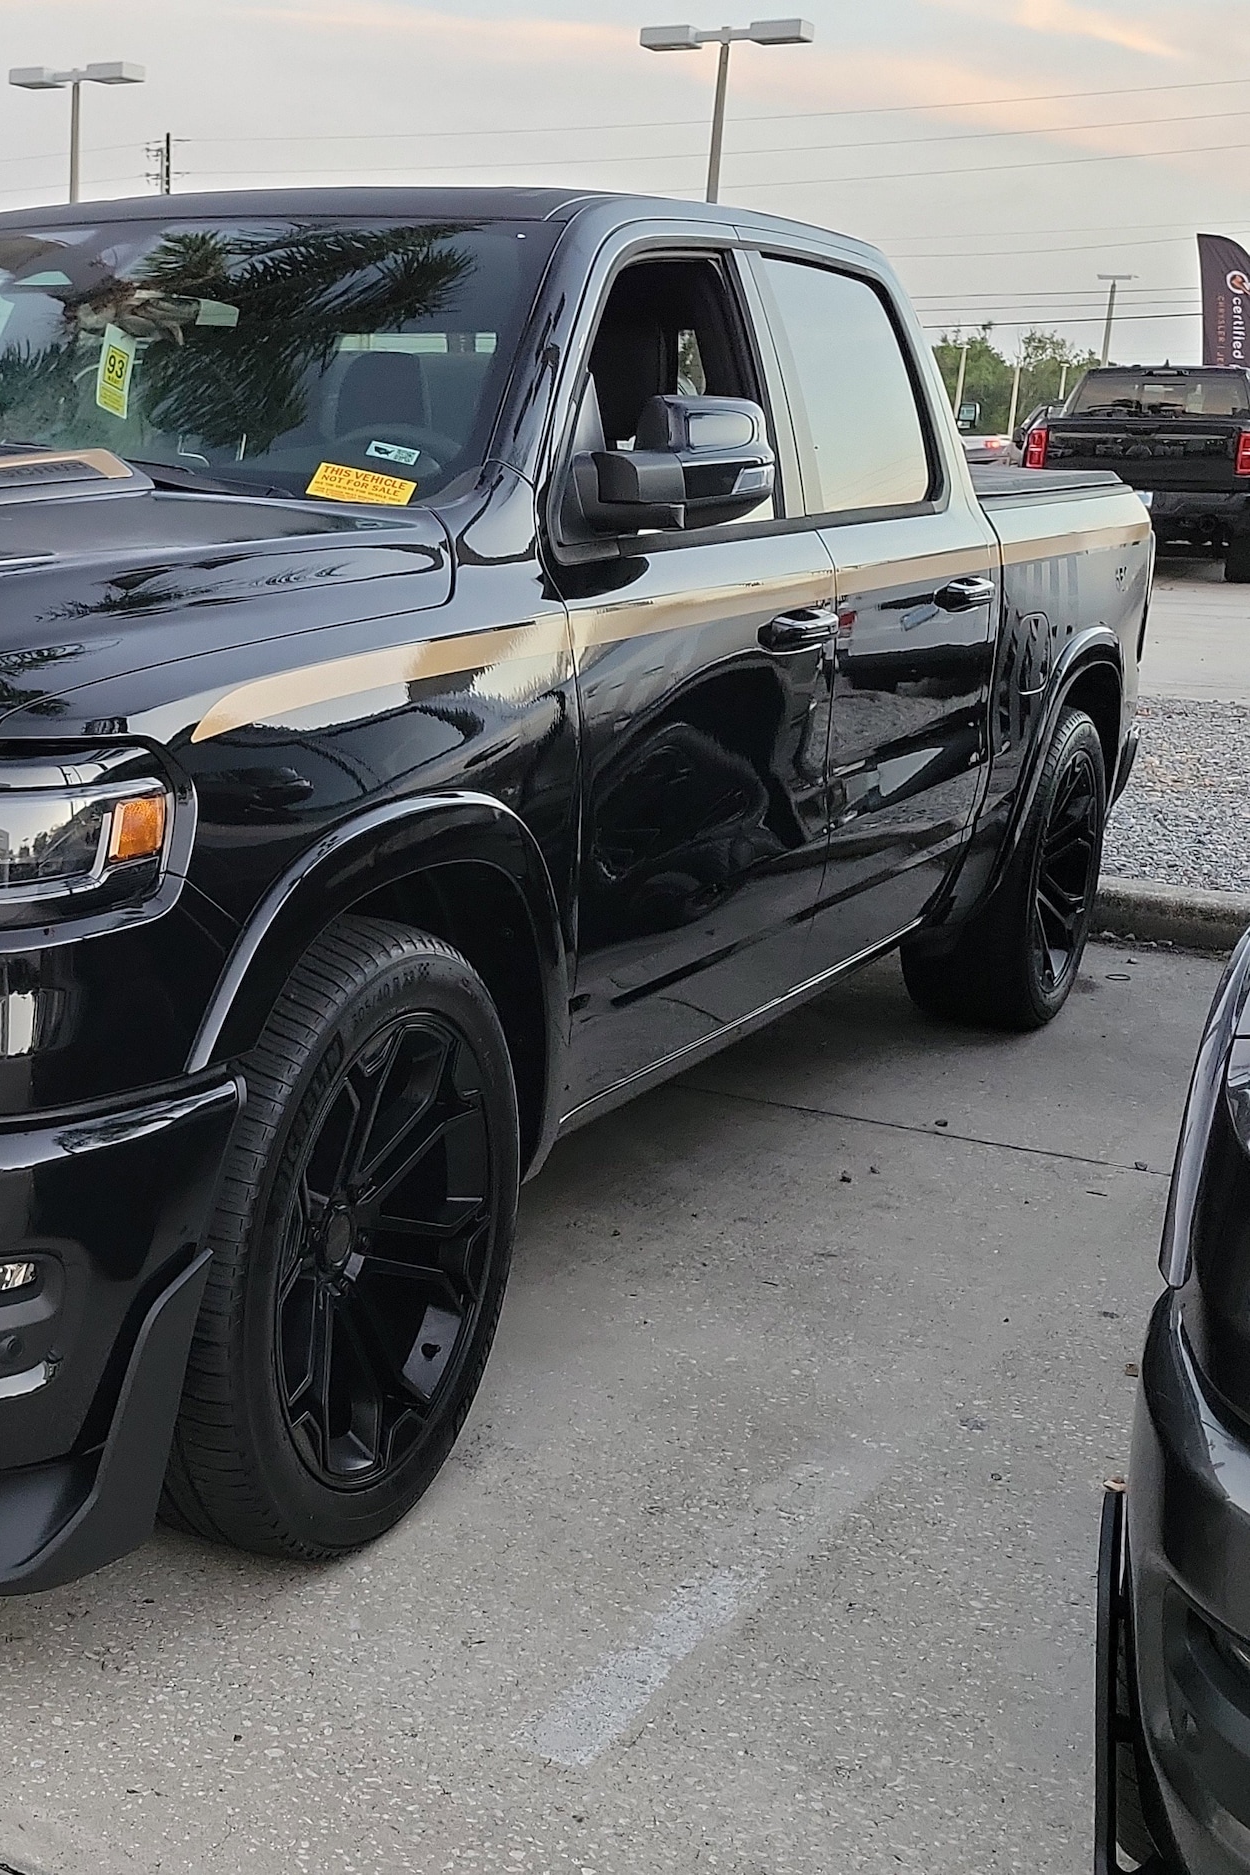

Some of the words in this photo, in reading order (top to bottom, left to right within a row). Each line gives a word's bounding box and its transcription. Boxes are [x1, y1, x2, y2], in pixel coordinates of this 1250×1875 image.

[1232, 296, 1246, 360] certified
[107, 354, 125, 379] 93
[321, 474, 344, 483] NOT
[346, 479, 369, 490] FOR
[372, 485, 401, 497] SALE
[324, 465, 351, 478] THIS
[355, 471, 408, 491] VEHICLE
